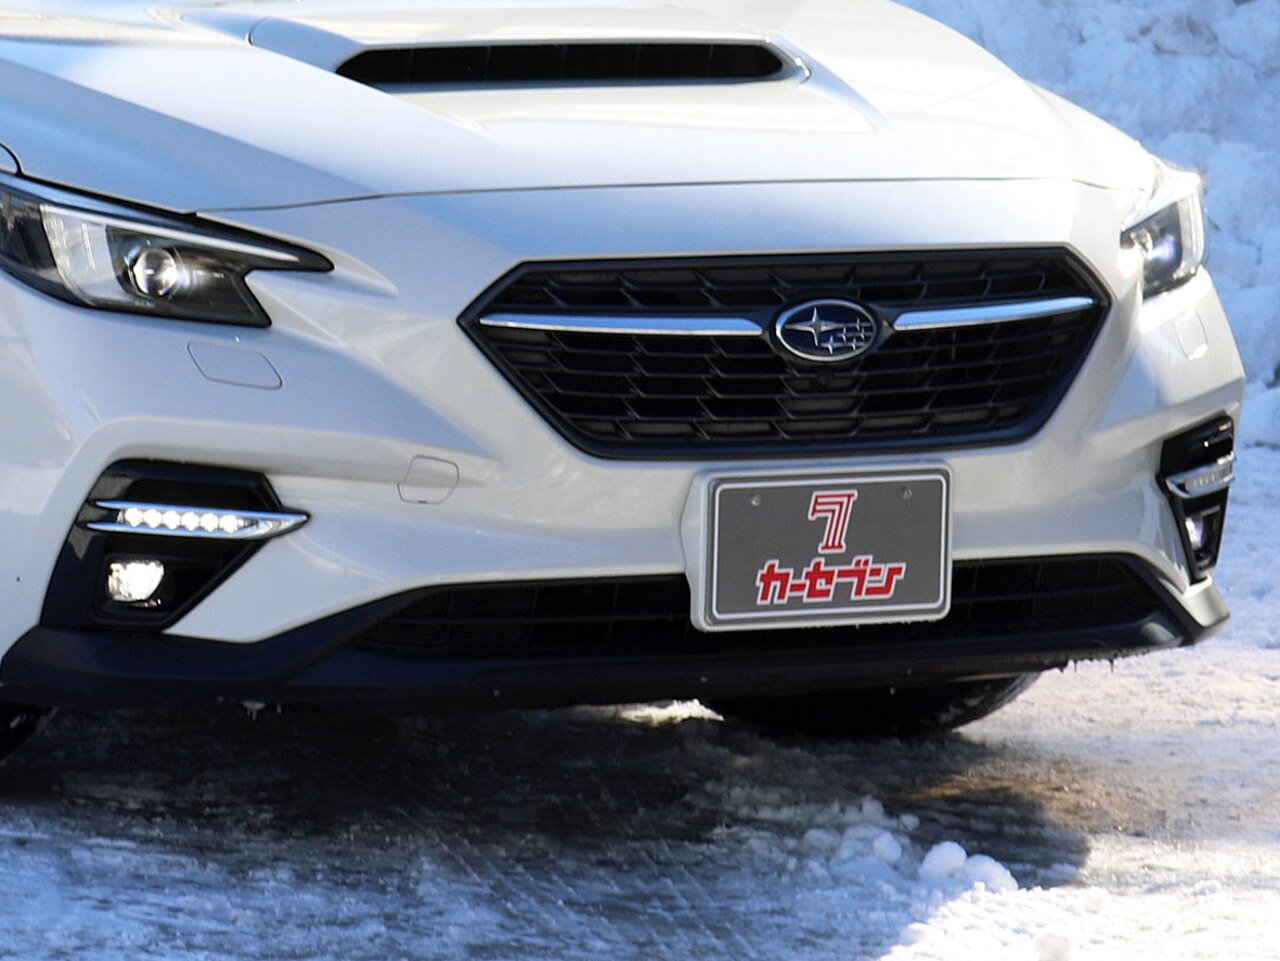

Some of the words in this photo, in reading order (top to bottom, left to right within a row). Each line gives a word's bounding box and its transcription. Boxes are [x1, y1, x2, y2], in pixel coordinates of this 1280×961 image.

[757, 556, 905, 604] カーセブン
